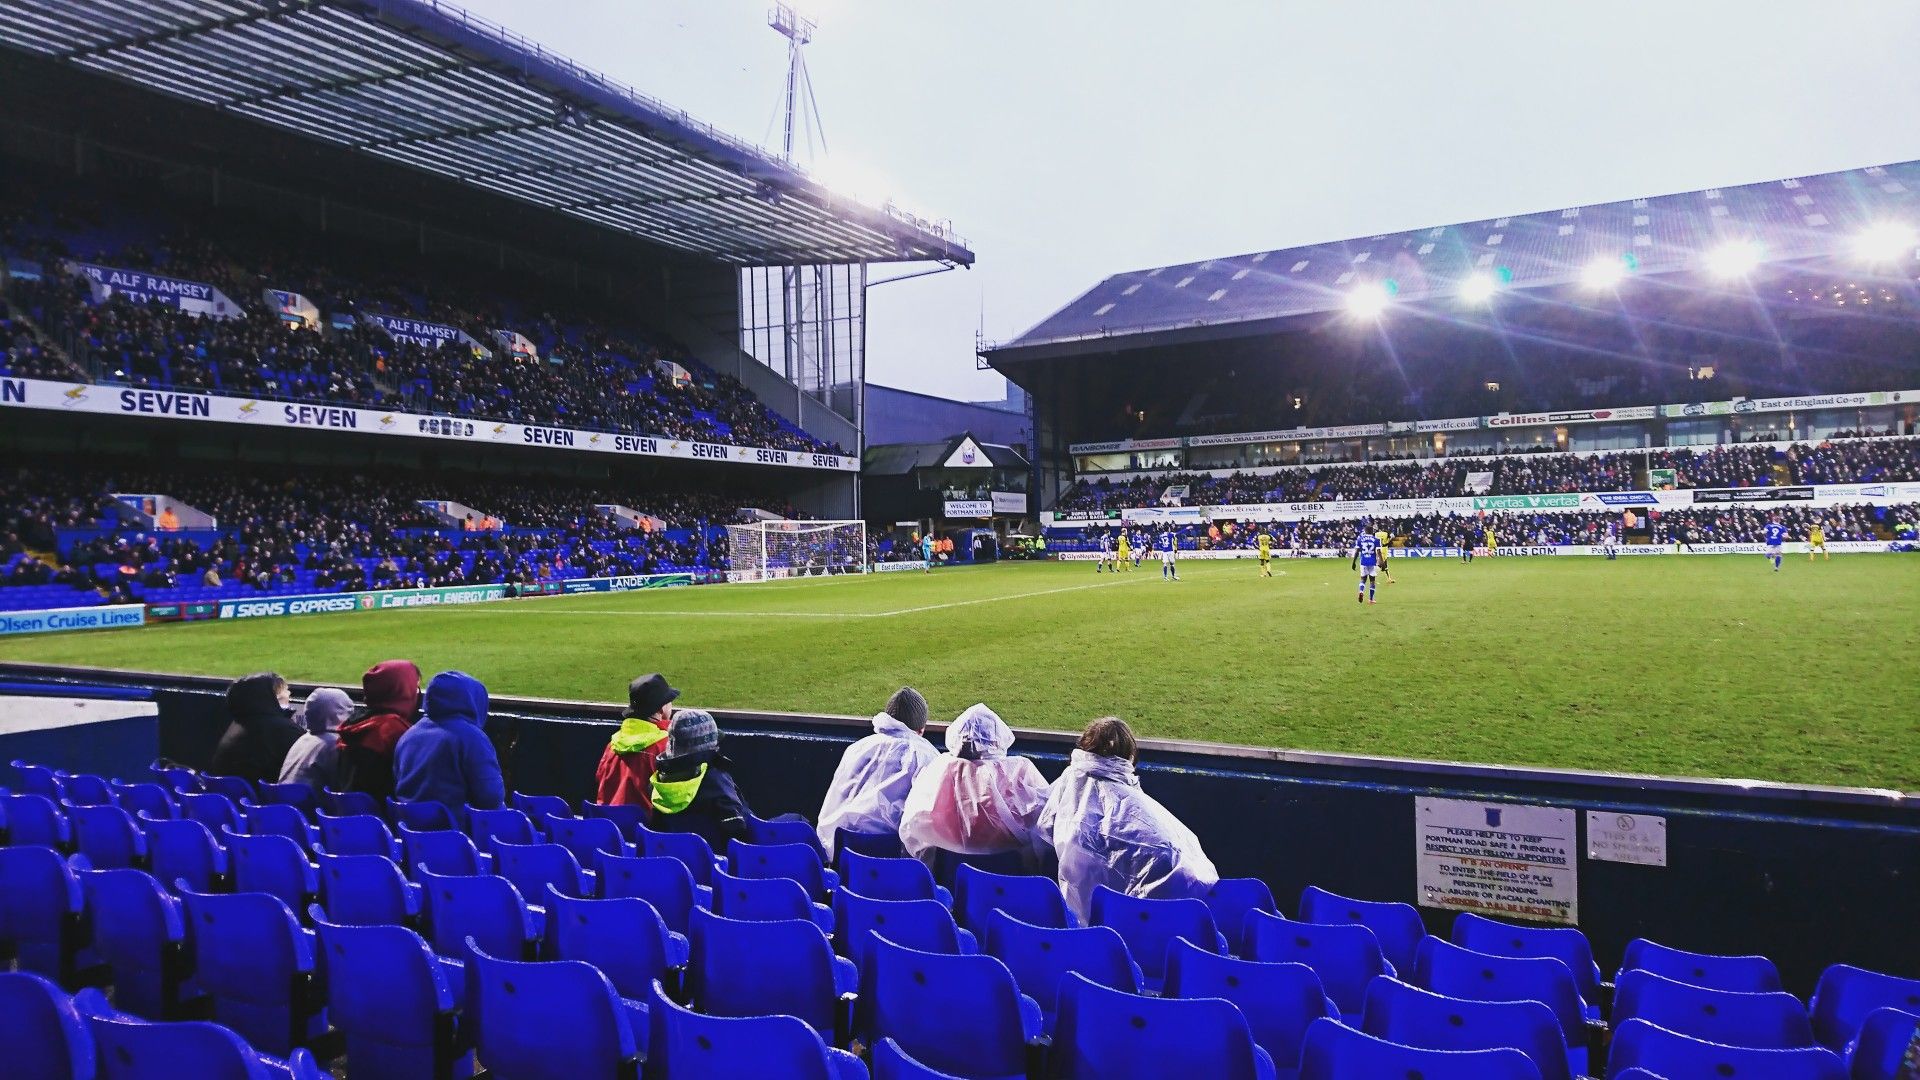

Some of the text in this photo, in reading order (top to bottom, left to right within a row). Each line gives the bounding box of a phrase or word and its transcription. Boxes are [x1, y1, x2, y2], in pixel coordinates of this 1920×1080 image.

[110, 271, 141, 287] ALF
[147, 277, 210, 299] RAMSEY
[389, 319, 410, 332] ALF
[413, 322, 457, 340] RAMSEY
[1795, 398, 1834, 407] England
[1837, 396, 1865, 405] Co-op
[1418, 419, 1478, 431] www.itfc.co.uk
[1490, 415, 1546, 426] Collins
[120, 390, 210, 417] SEVEN
[284, 405, 357, 428] SEVEN
[523, 426, 574, 446] SEVEN
[615, 436, 657, 453] SEVEN
[692, 443, 728, 459] SEVEN
[756, 449, 788, 464] SEVEN
[812, 453, 840, 468] SEVEN
[1291, 503, 1324, 511] GLOBEX
[1490, 495, 1578, 509] vertas vertas
[1772, 527, 1779, 536] 9
[1360, 542, 1375, 555] 32
[1719, 545, 1755, 554] England
[610, 576, 650, 588] LANDEX
[381, 592, 441, 607] Carabao
[443, 590, 485, 603] ENERGY
[237, 598, 356, 617] SIGNS EXPRESS
[47, 613, 98, 628] Cruise
[102, 610, 141, 625] Lines
[1446, 827, 1543, 844] PLEASE HELP US TO KEEP
[1602, 831, 1626, 841] THIS
[1425, 834, 1463, 845] PORTMAN
[1465, 838, 1487, 848] ROAD
[1489, 841, 1508, 849] SAFE
[1519, 844, 1556, 854] FRIENDLY
[1592, 840, 1661, 854] NO SMOKING
[1425, 842, 1567, 865] RESPECT YOUR FELLOW SUPPORTERS
[1439, 864, 1450, 872] TO
[1452, 866, 1477, 875] ENTER
[1479, 868, 1495, 877] THE
[1496, 870, 1518, 879] FIELD
[1532, 874, 1553, 883] PLAY
[1479, 860, 1491, 868] AN
[1494, 862, 1530, 872] OFFENCE
[1453, 879, 1497, 890] PERSISTENT
[1498, 885, 1538, 896] STANDING
[1447, 888, 1480, 898] ABUSIVE
[1495, 893, 1525, 904] RACIAL
[1526, 896, 1571, 909] CHANTING
